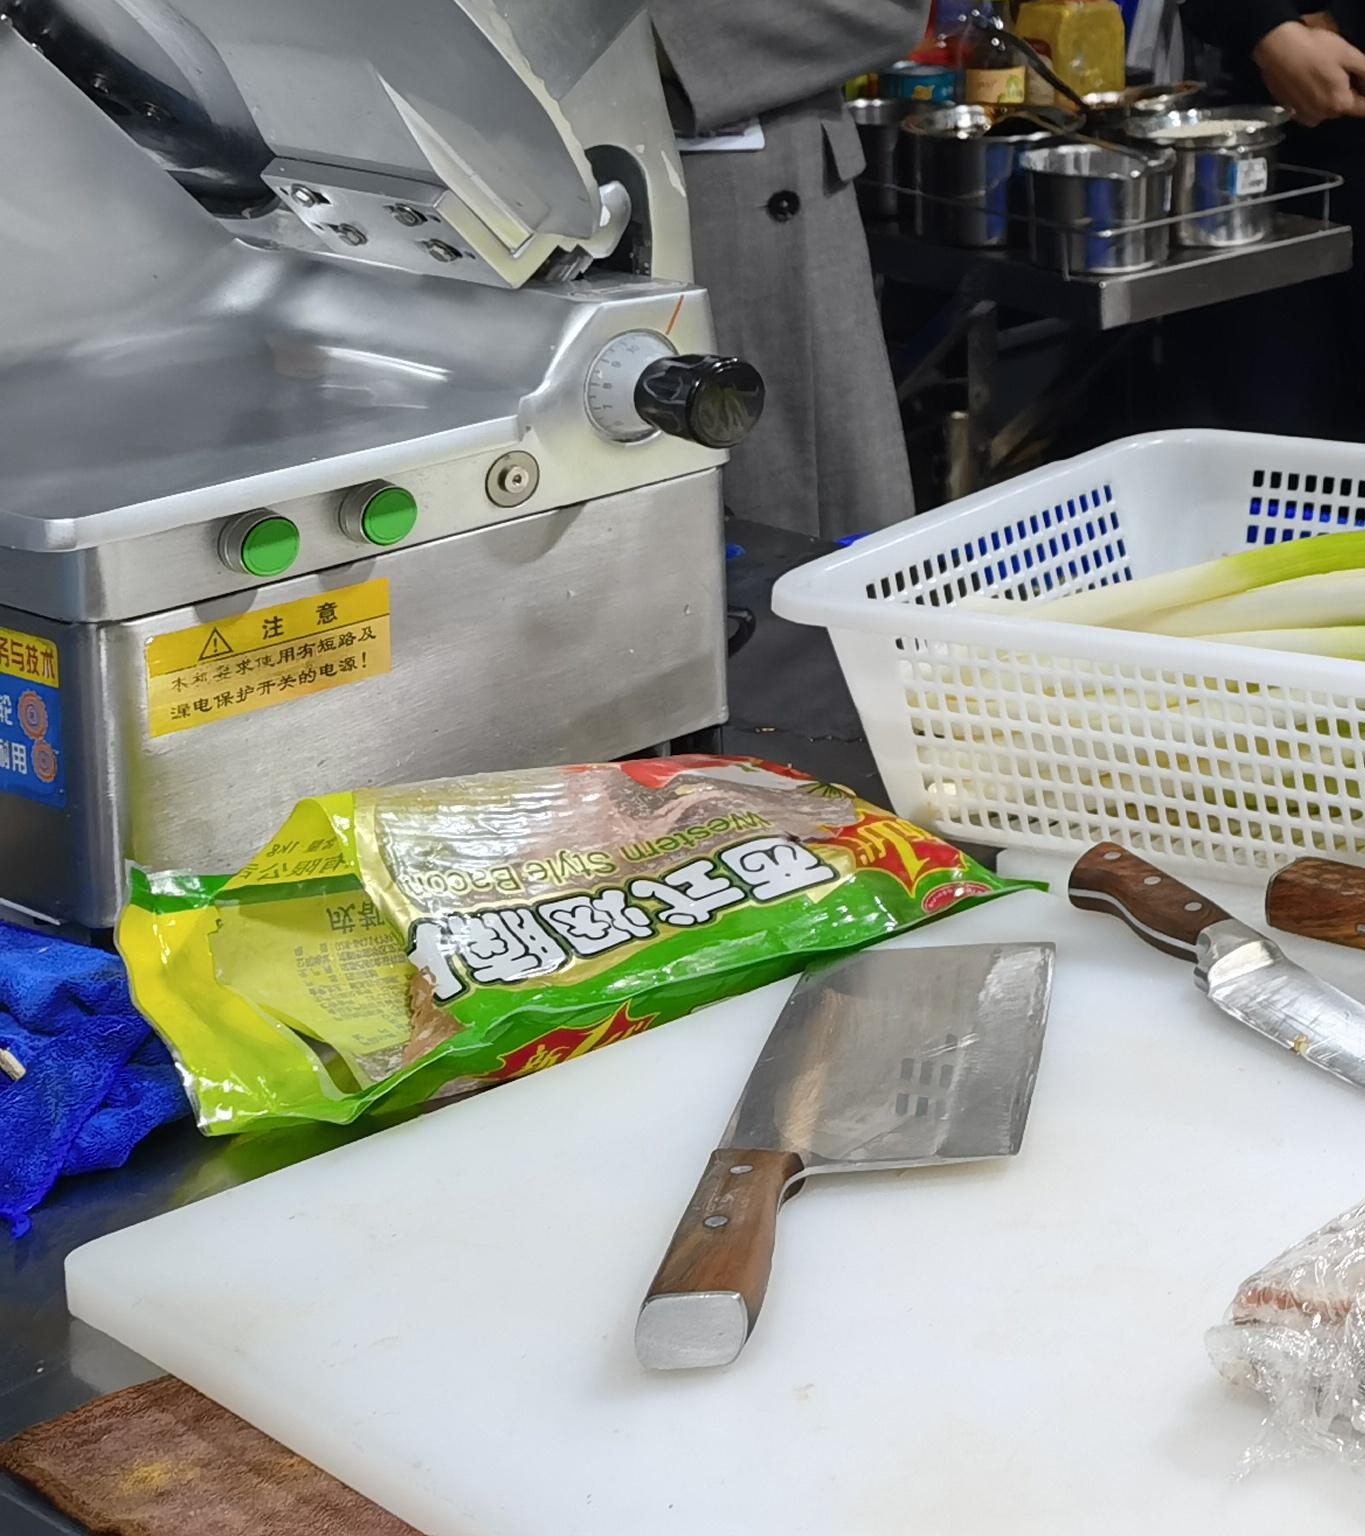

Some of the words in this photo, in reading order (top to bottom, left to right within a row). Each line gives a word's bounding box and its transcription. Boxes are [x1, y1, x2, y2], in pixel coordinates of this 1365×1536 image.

[262, 601, 339, 640] 注意
[620, 810, 775, 860] Western
[403, 864, 523, 895] Bacon
[525, 850, 617, 885] Style
